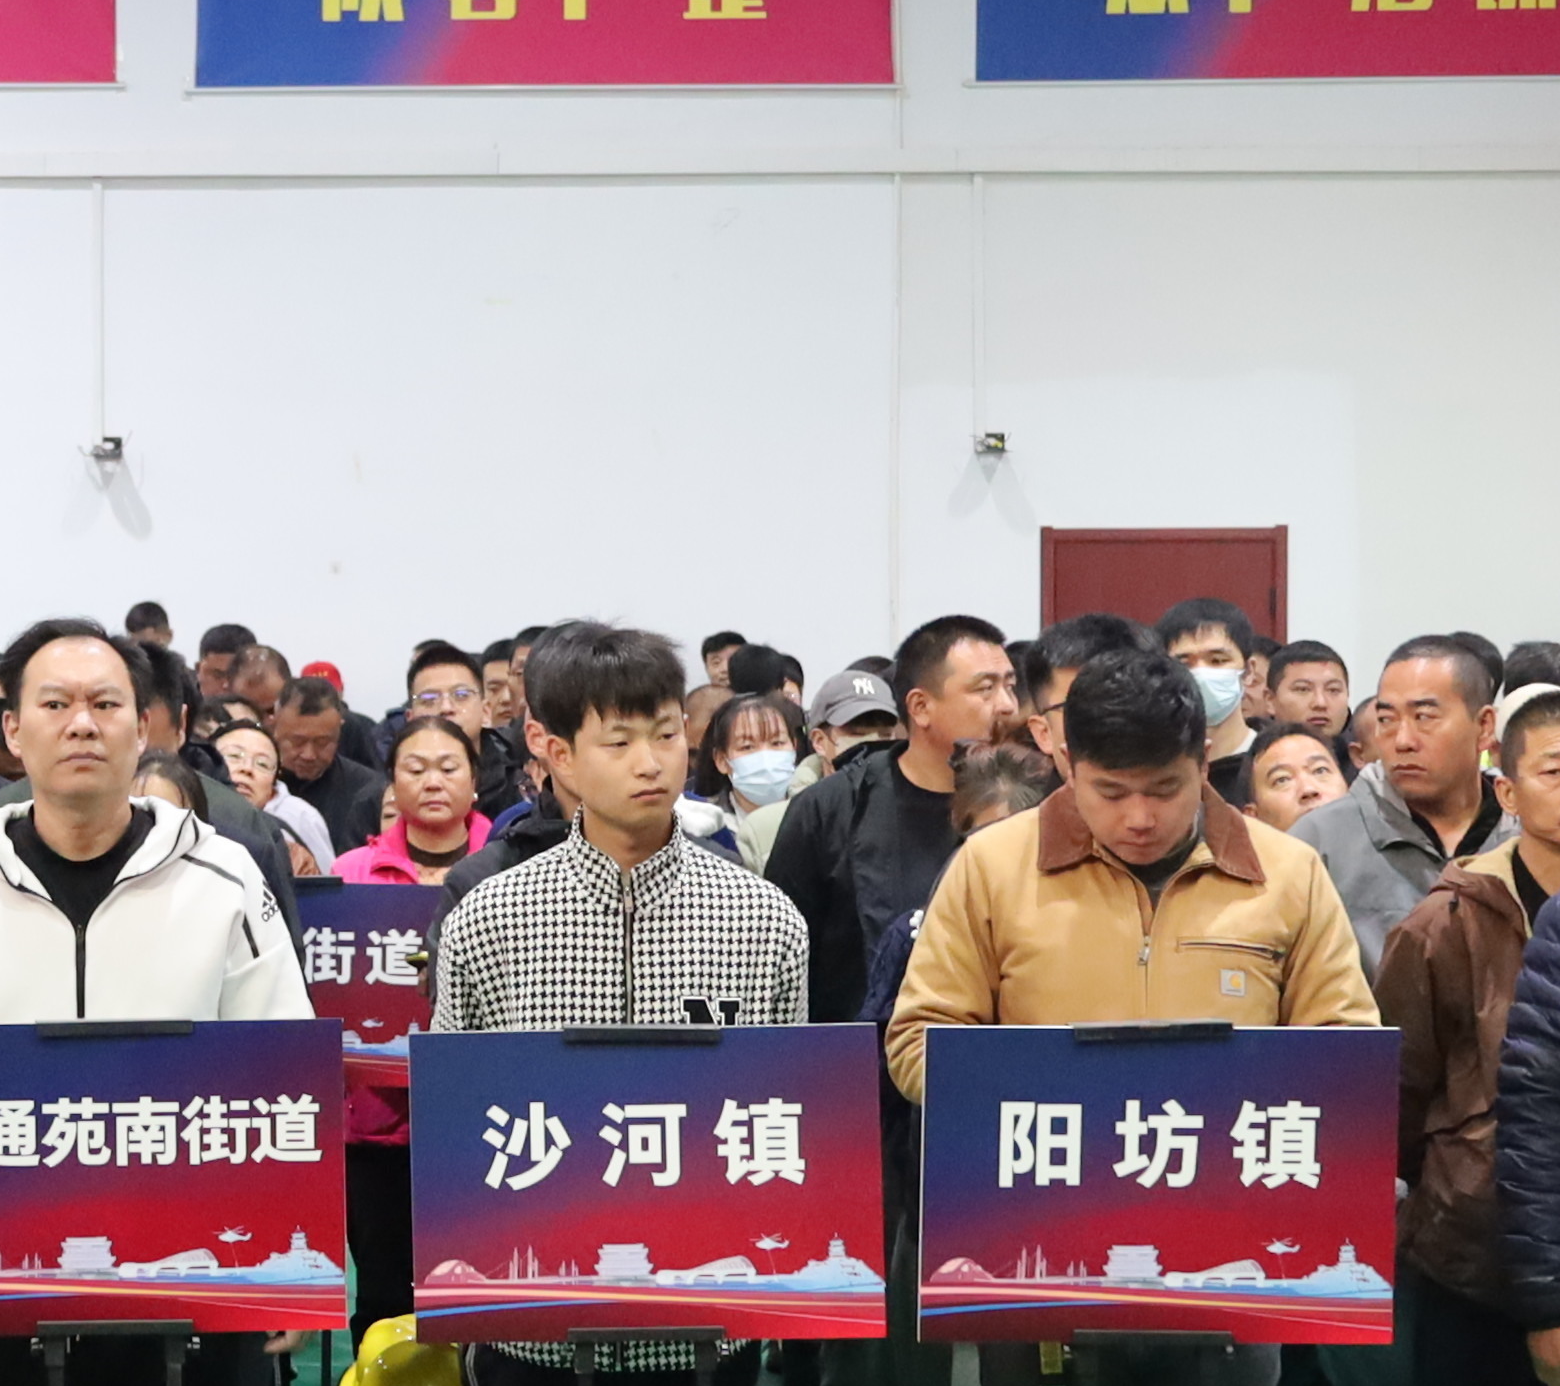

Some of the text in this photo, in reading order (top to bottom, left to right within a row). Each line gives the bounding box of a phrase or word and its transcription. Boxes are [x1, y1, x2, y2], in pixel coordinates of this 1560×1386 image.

[303, 927, 423, 985] 街道
[483, 1098, 805, 1190] 沙河镇
[999, 1100, 1320, 1188] 阳坊镇
